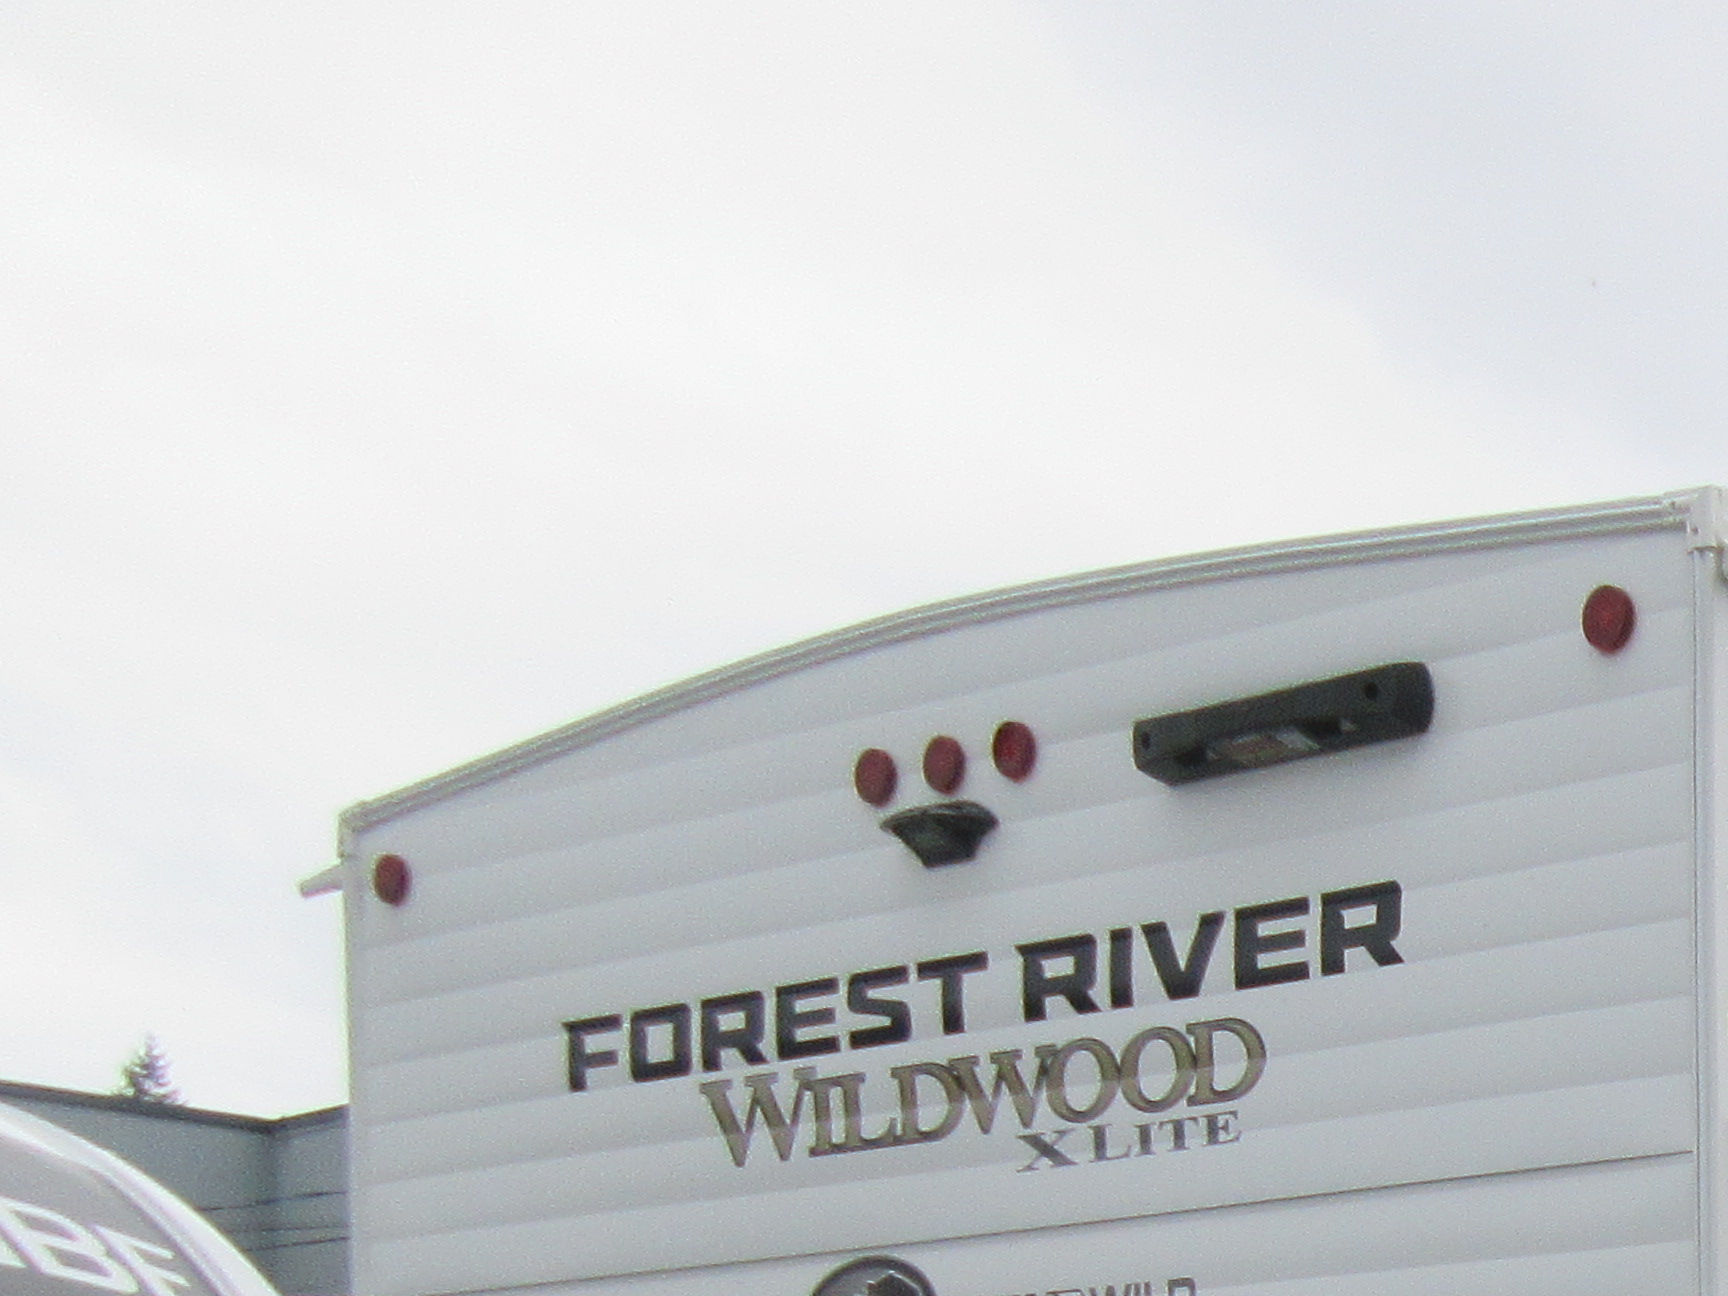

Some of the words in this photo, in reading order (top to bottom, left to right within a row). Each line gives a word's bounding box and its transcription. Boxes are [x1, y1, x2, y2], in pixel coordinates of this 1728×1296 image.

[561, 950, 990, 1093] FOREST
[1014, 879, 1405, 1023] RIVER
[699, 1016, 1269, 1169] WILDWOOD
